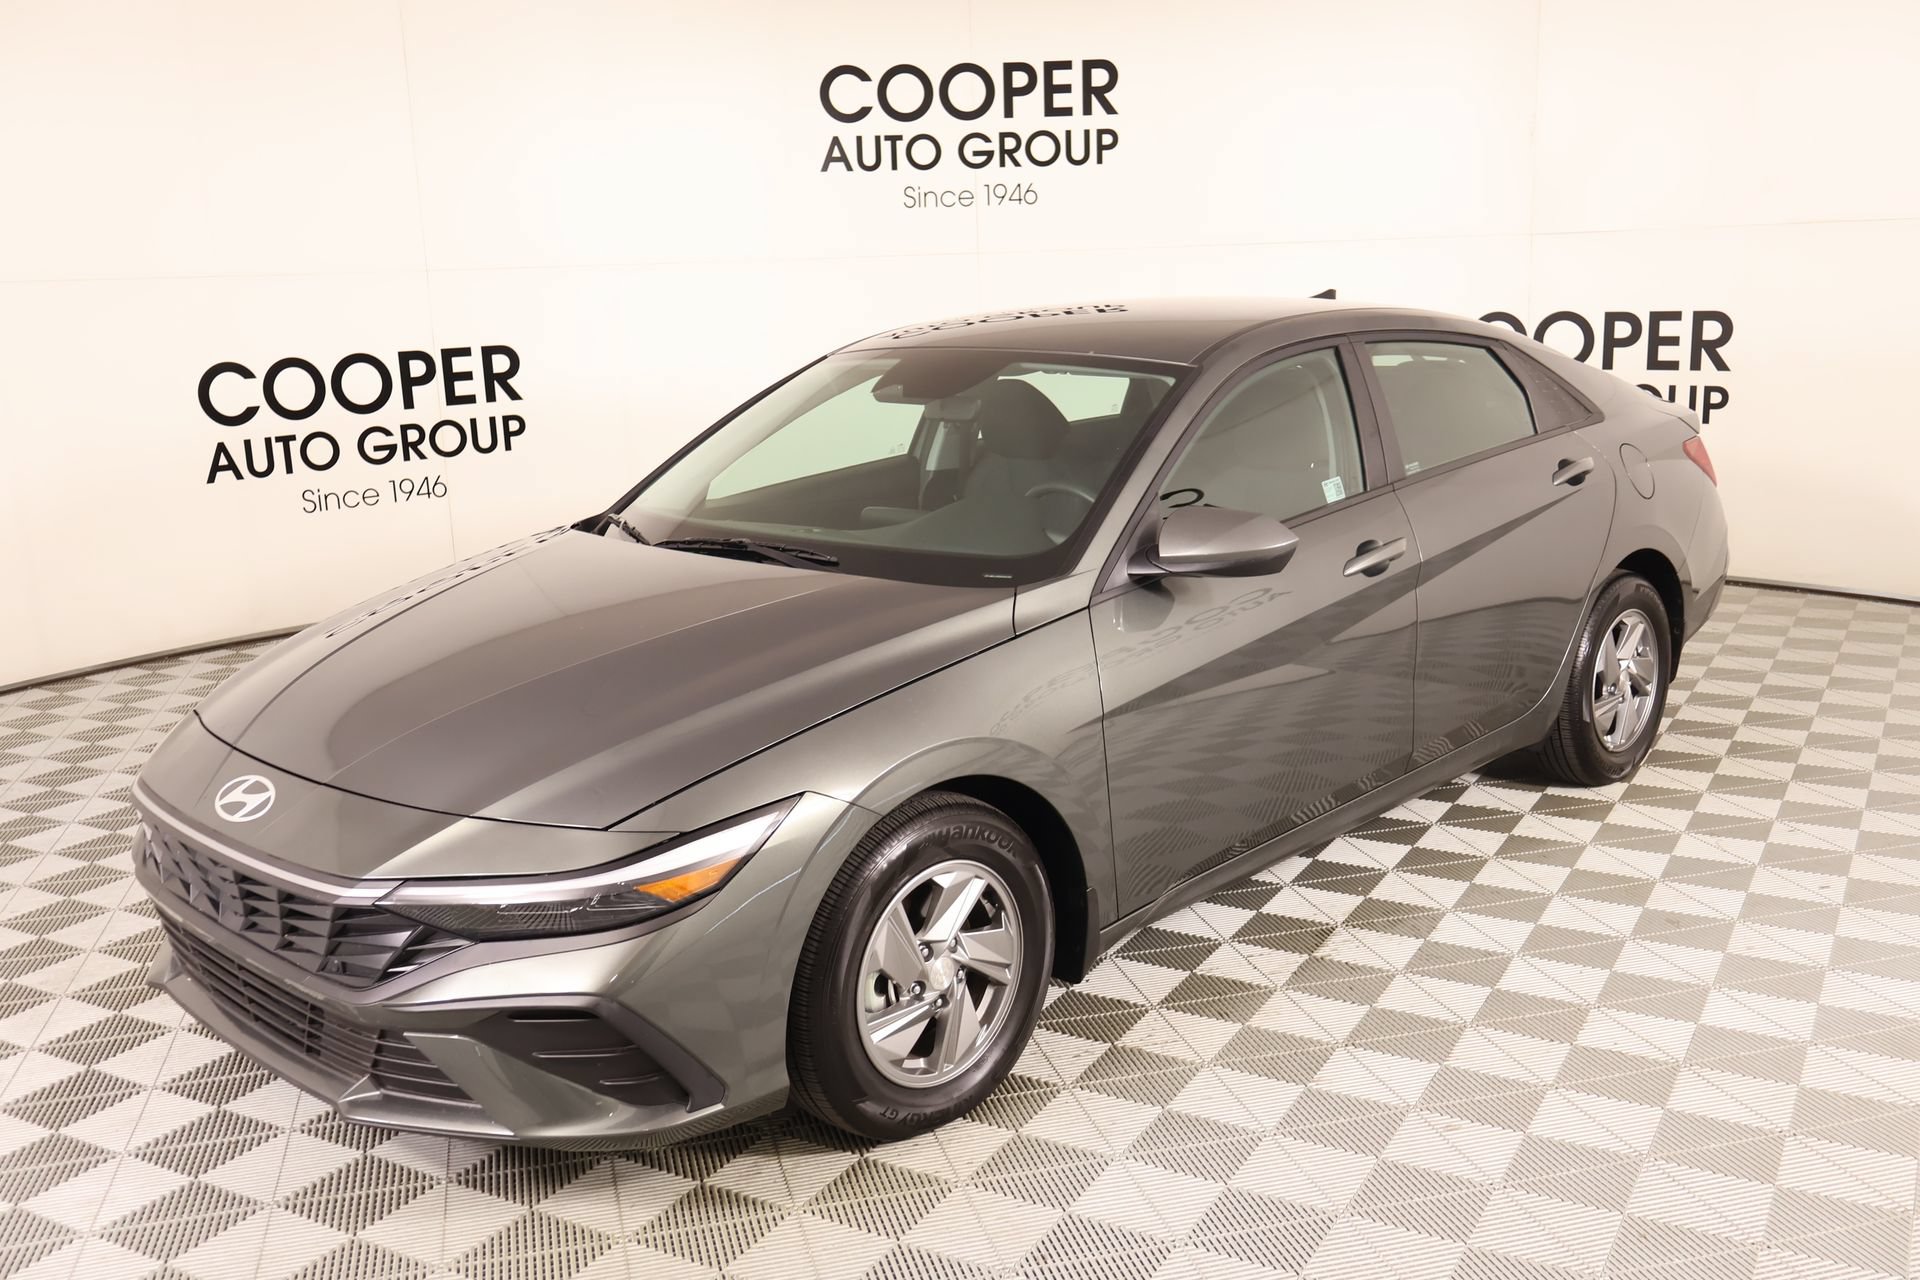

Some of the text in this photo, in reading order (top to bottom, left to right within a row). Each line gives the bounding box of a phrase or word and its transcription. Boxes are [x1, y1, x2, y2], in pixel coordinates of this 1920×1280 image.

[819, 59, 1119, 124] COOPER
[820, 129, 1119, 173] AUTO GROUP
[903, 182, 1038, 209] Since 1946
[197, 344, 524, 427] COOPER
[206, 414, 527, 485] AUTO GROUP
[301, 474, 448, 514] Since 1946
